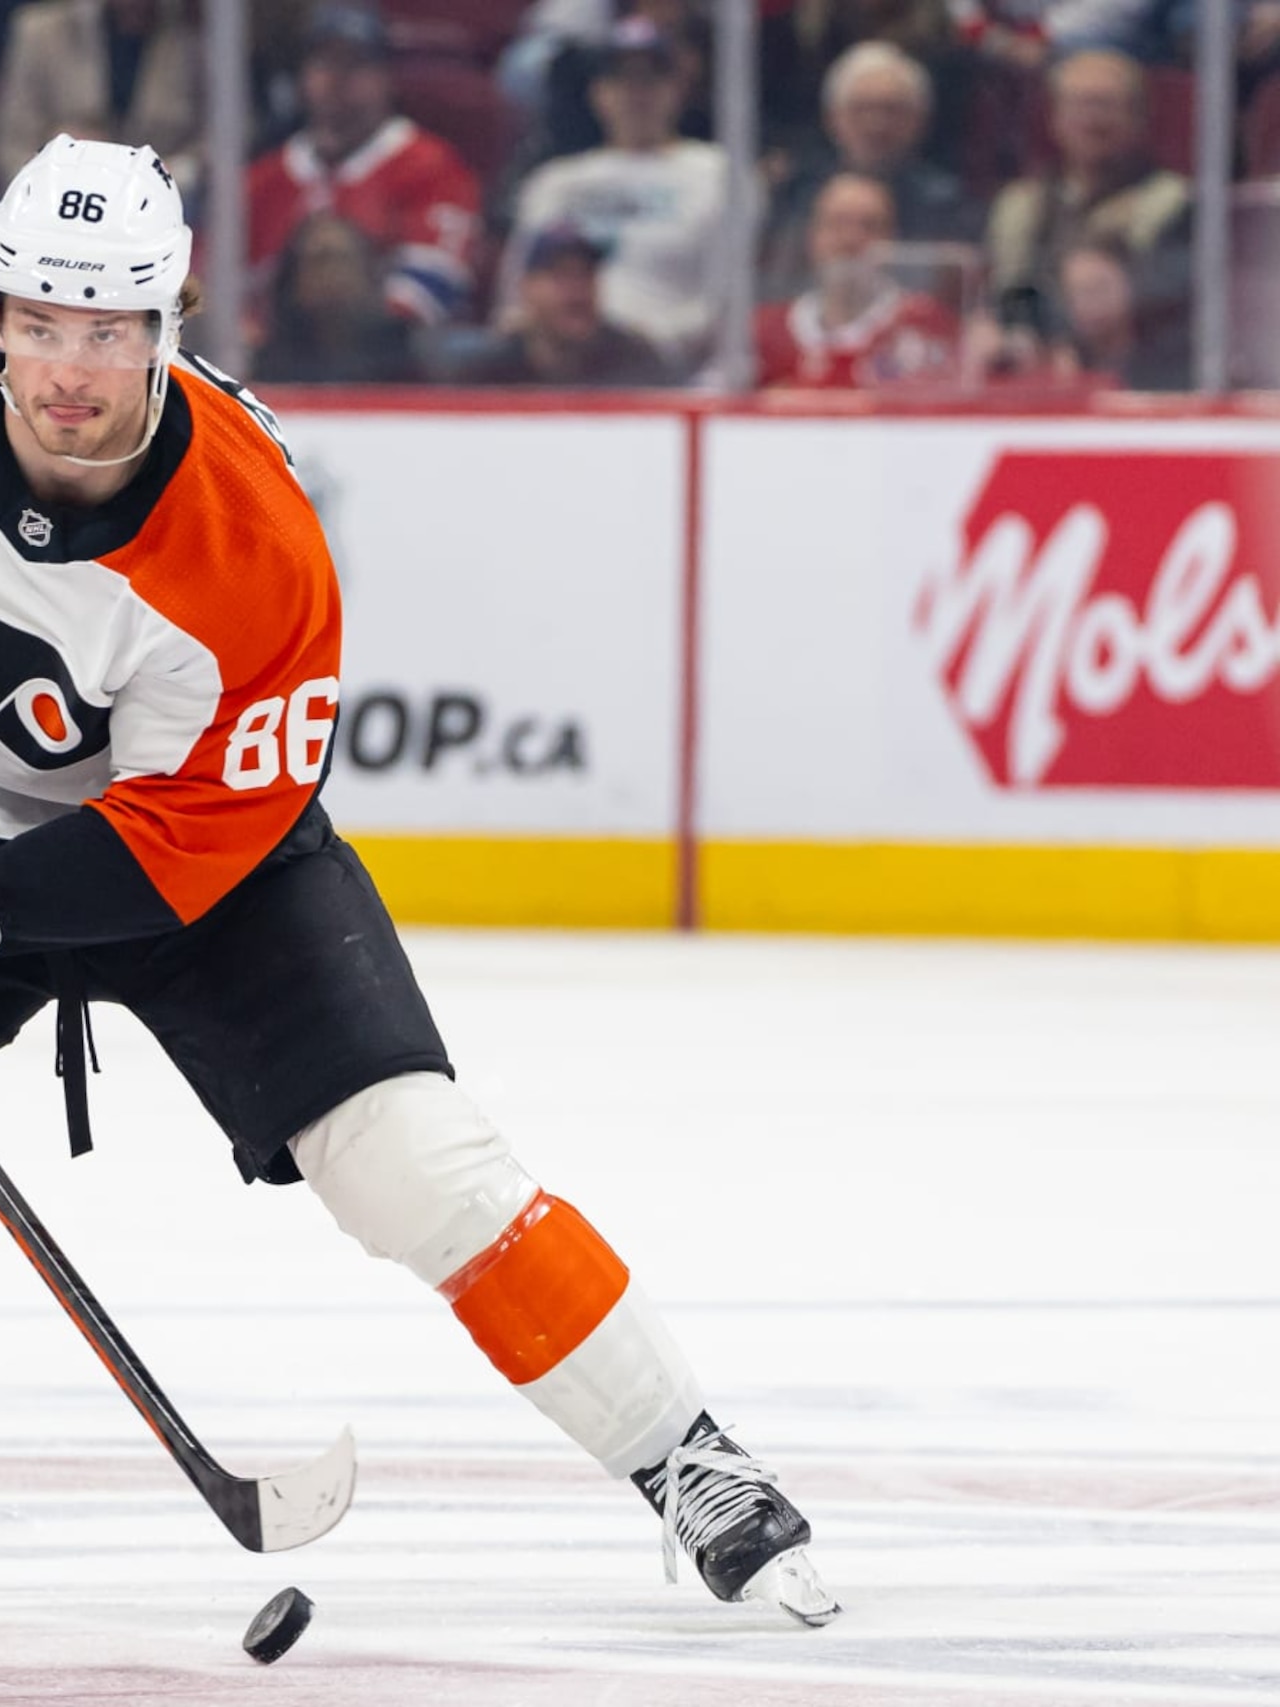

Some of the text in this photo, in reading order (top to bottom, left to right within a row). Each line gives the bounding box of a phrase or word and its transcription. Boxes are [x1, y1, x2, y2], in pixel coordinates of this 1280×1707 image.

[57, 190, 107, 223] 86
[37, 256, 106, 273] BAUER
[920, 499, 1280, 790] Mols
[222, 675, 339, 792] 86
[333, 690, 589, 777] OP.CA
